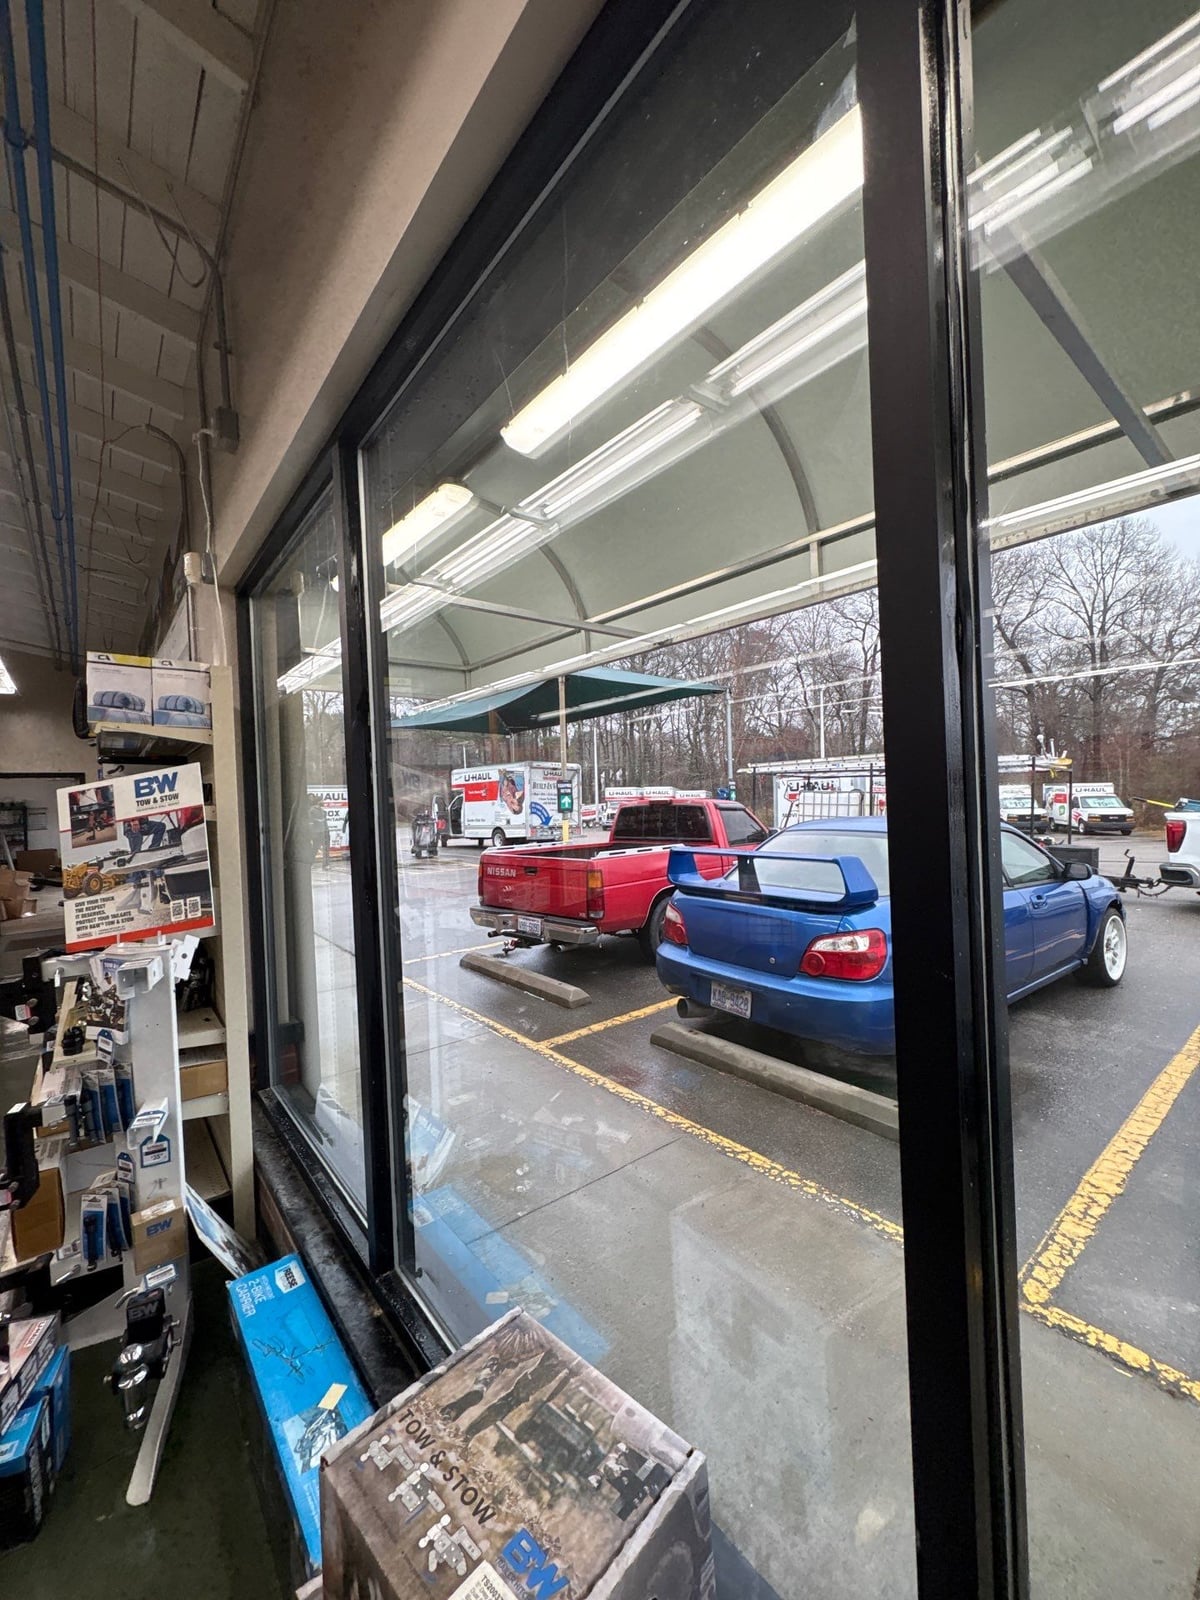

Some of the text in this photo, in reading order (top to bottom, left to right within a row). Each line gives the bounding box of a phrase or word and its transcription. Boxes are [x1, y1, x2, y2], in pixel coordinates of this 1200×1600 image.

[464, 772, 492, 782] U-HAUL
[136, 799, 151, 807] TOW
[159, 793, 179, 803] STOW
[487, 867, 517, 877] NISSAN
[76, 917, 97, 925] PROTECT
[110, 911, 131, 919] TAILGATE
[81, 910, 106, 918] DESERVES.
[283, 1267, 298, 1288] REESE
[248, 1278, 267, 1305] 2-BIKE
[236, 1283, 256, 1318] CARRIER
[398, 1408, 497, 1525] TOW & STOW
[496, 1555, 520, 1586] TRAILER
